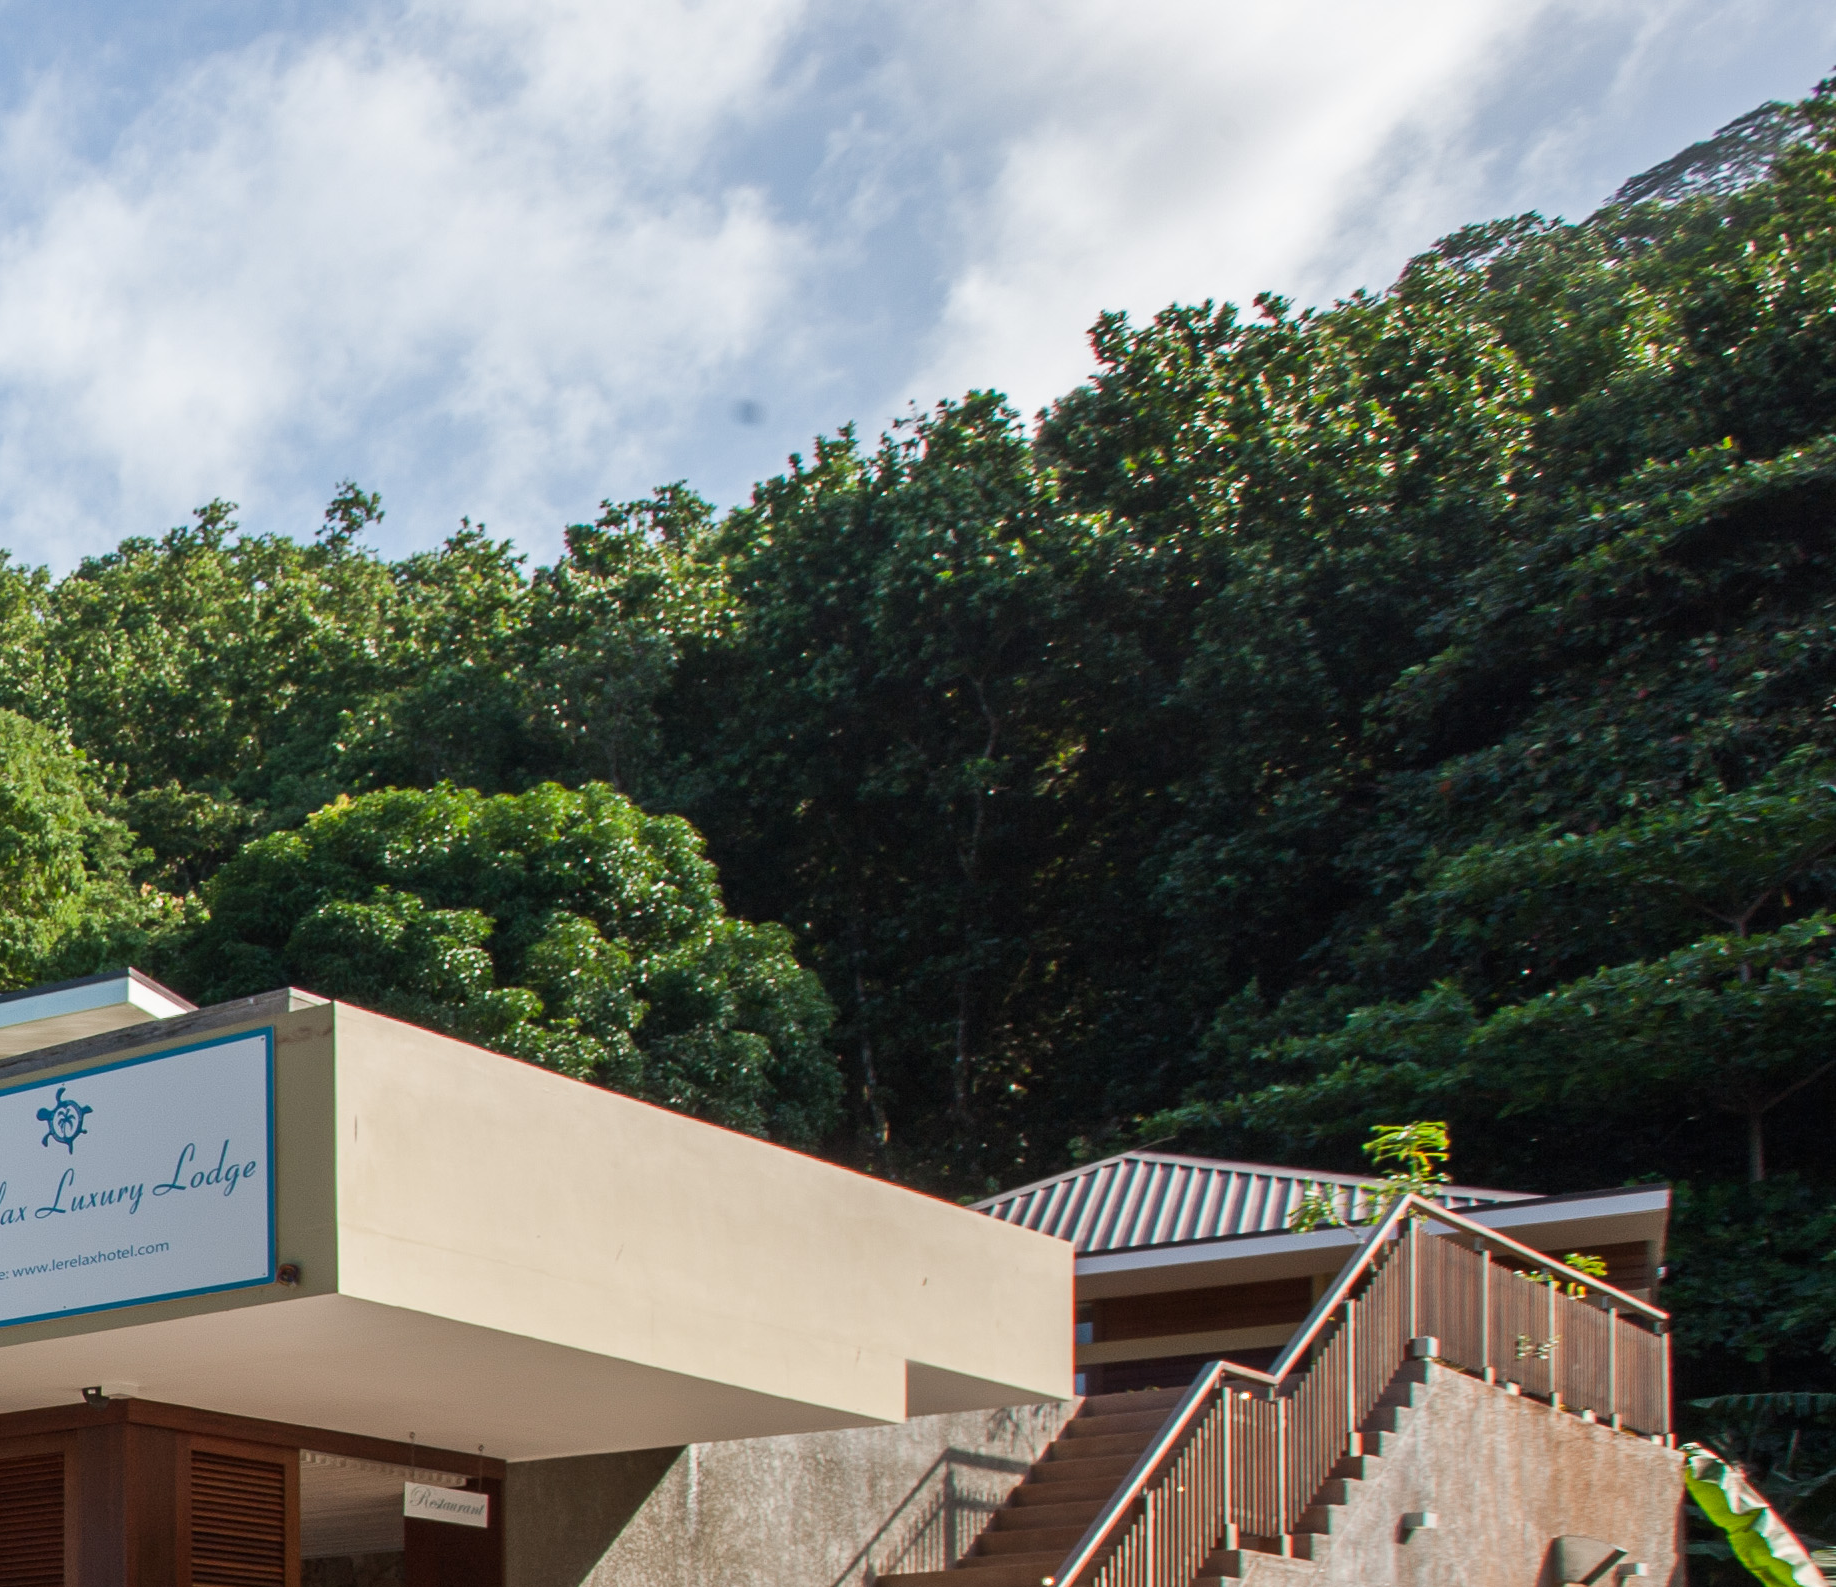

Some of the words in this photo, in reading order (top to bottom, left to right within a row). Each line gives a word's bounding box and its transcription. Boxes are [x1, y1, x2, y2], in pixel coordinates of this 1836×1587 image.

[34, 1168, 144, 1219] Luxury
[152, 1139, 257, 1197] Lodge
[11, 1241, 170, 1278] www.lerelaxhotel.com
[409, 1485, 486, 1515] Restaurant
